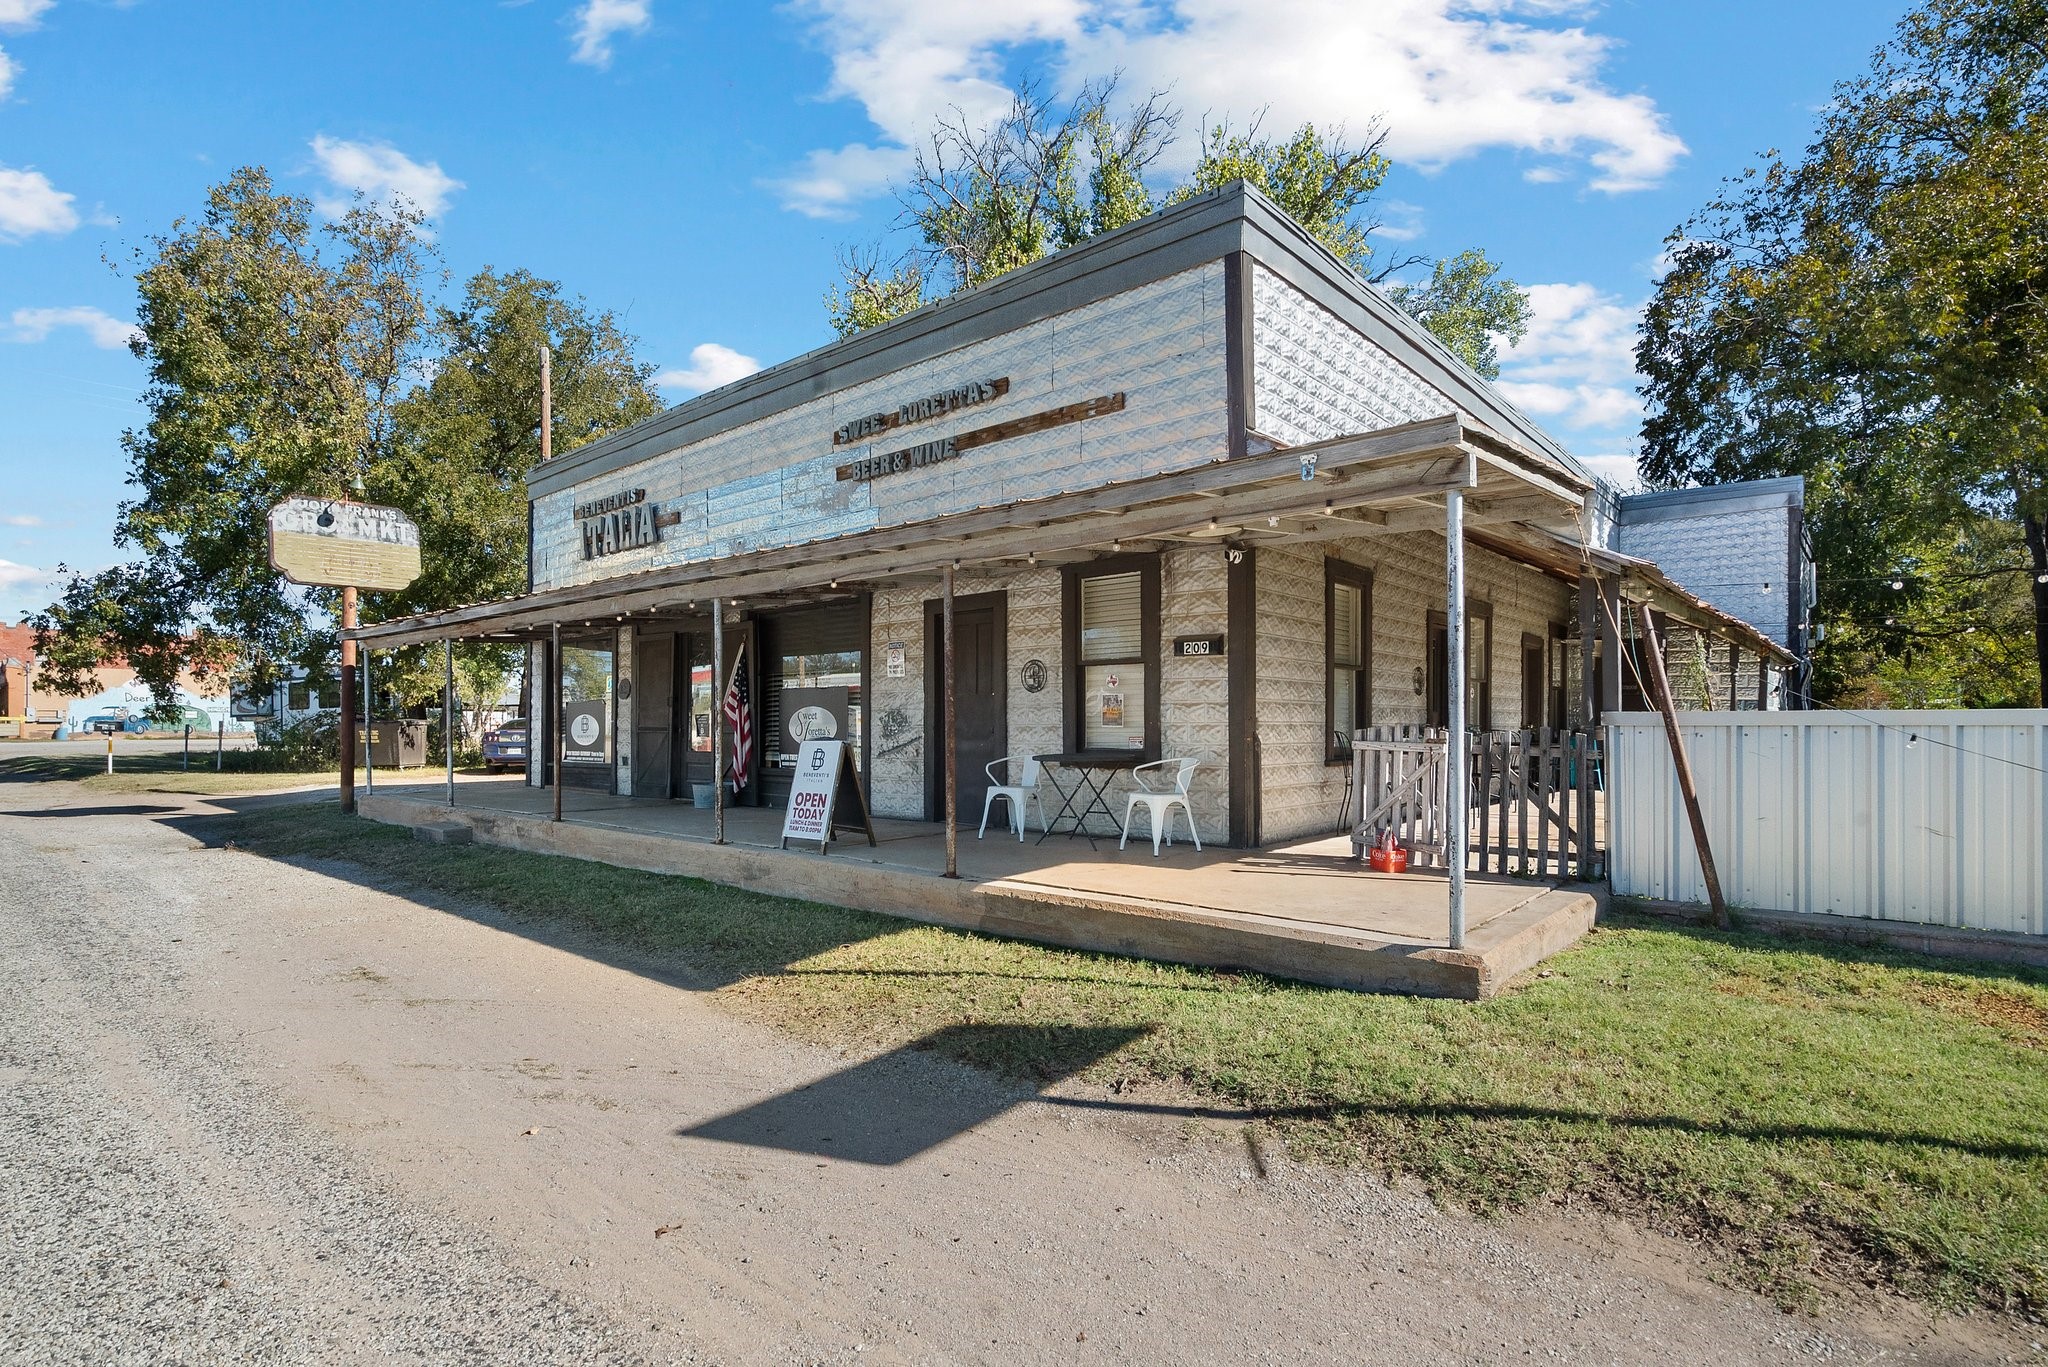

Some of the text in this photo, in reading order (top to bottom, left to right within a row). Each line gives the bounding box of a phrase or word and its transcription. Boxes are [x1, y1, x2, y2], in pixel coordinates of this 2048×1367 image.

[899, 378, 998, 423] LORETTAS
[852, 437, 957, 481] BEER & WINE
[299, 499, 397, 520] JOHN FRANK'S
[579, 488, 637, 519] BENEVENTIS
[582, 502, 657, 560] ITALIA
[1185, 642, 1208, 654] 209
[795, 792, 828, 808] OPEN
[793, 807, 825, 820] TODAY
[1372, 850, 1386, 859] Coke
